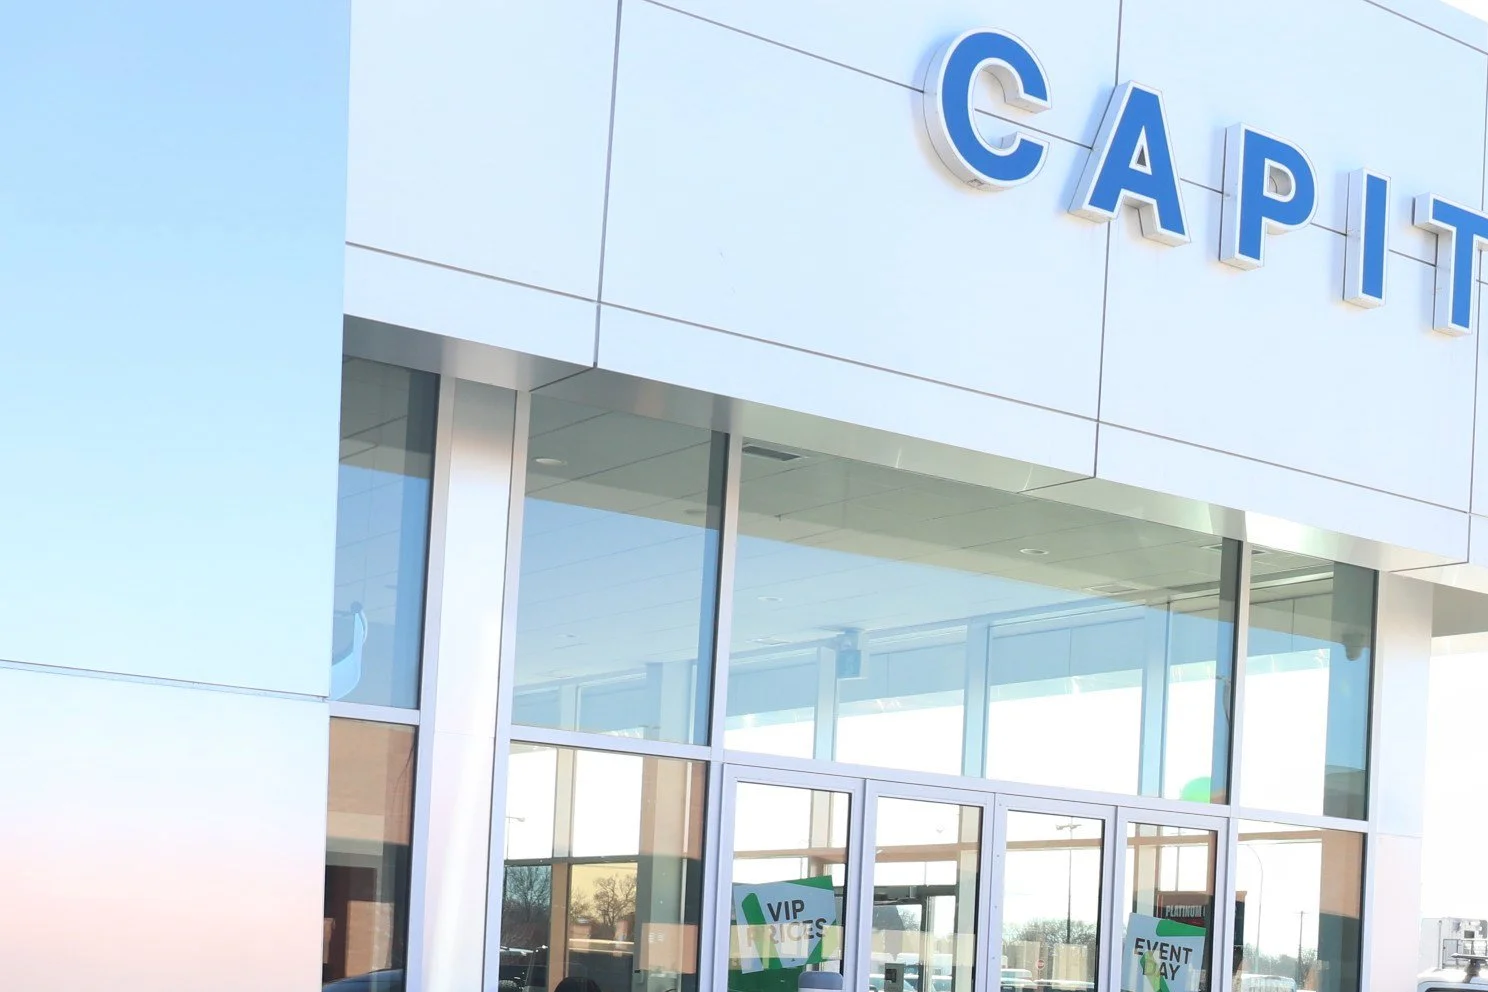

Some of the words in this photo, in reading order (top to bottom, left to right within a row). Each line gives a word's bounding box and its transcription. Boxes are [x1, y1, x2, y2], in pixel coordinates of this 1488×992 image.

[767, 899, 805, 922] VIP
[1165, 904, 1202, 918] PLATINUM
[747, 917, 828, 948] PRICES
[1134, 937, 1193, 965] EVENT
[1142, 960, 1181, 982] DAY
